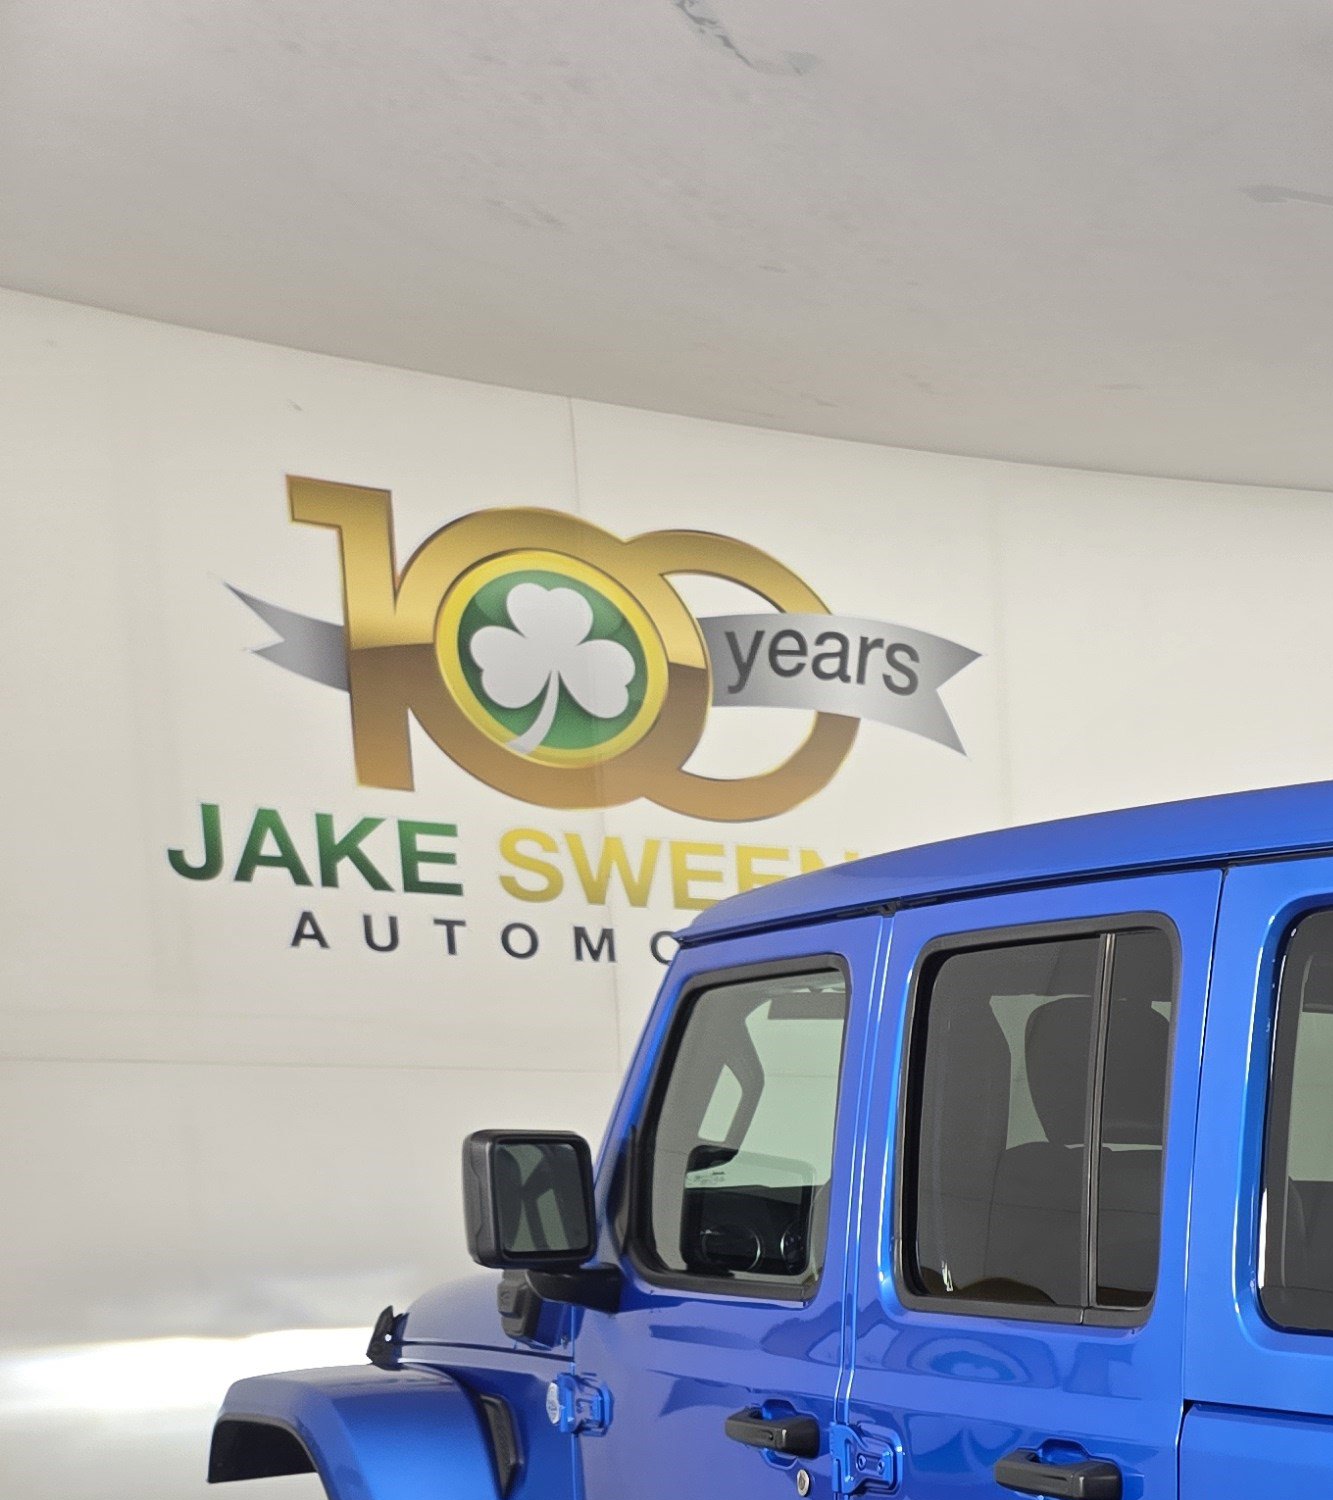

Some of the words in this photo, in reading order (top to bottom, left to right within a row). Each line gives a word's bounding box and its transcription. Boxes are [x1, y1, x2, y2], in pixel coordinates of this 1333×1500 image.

[724, 625, 922, 697] years
[167, 803, 465, 897] JAKE
[499, 827, 860, 912] SWEE
